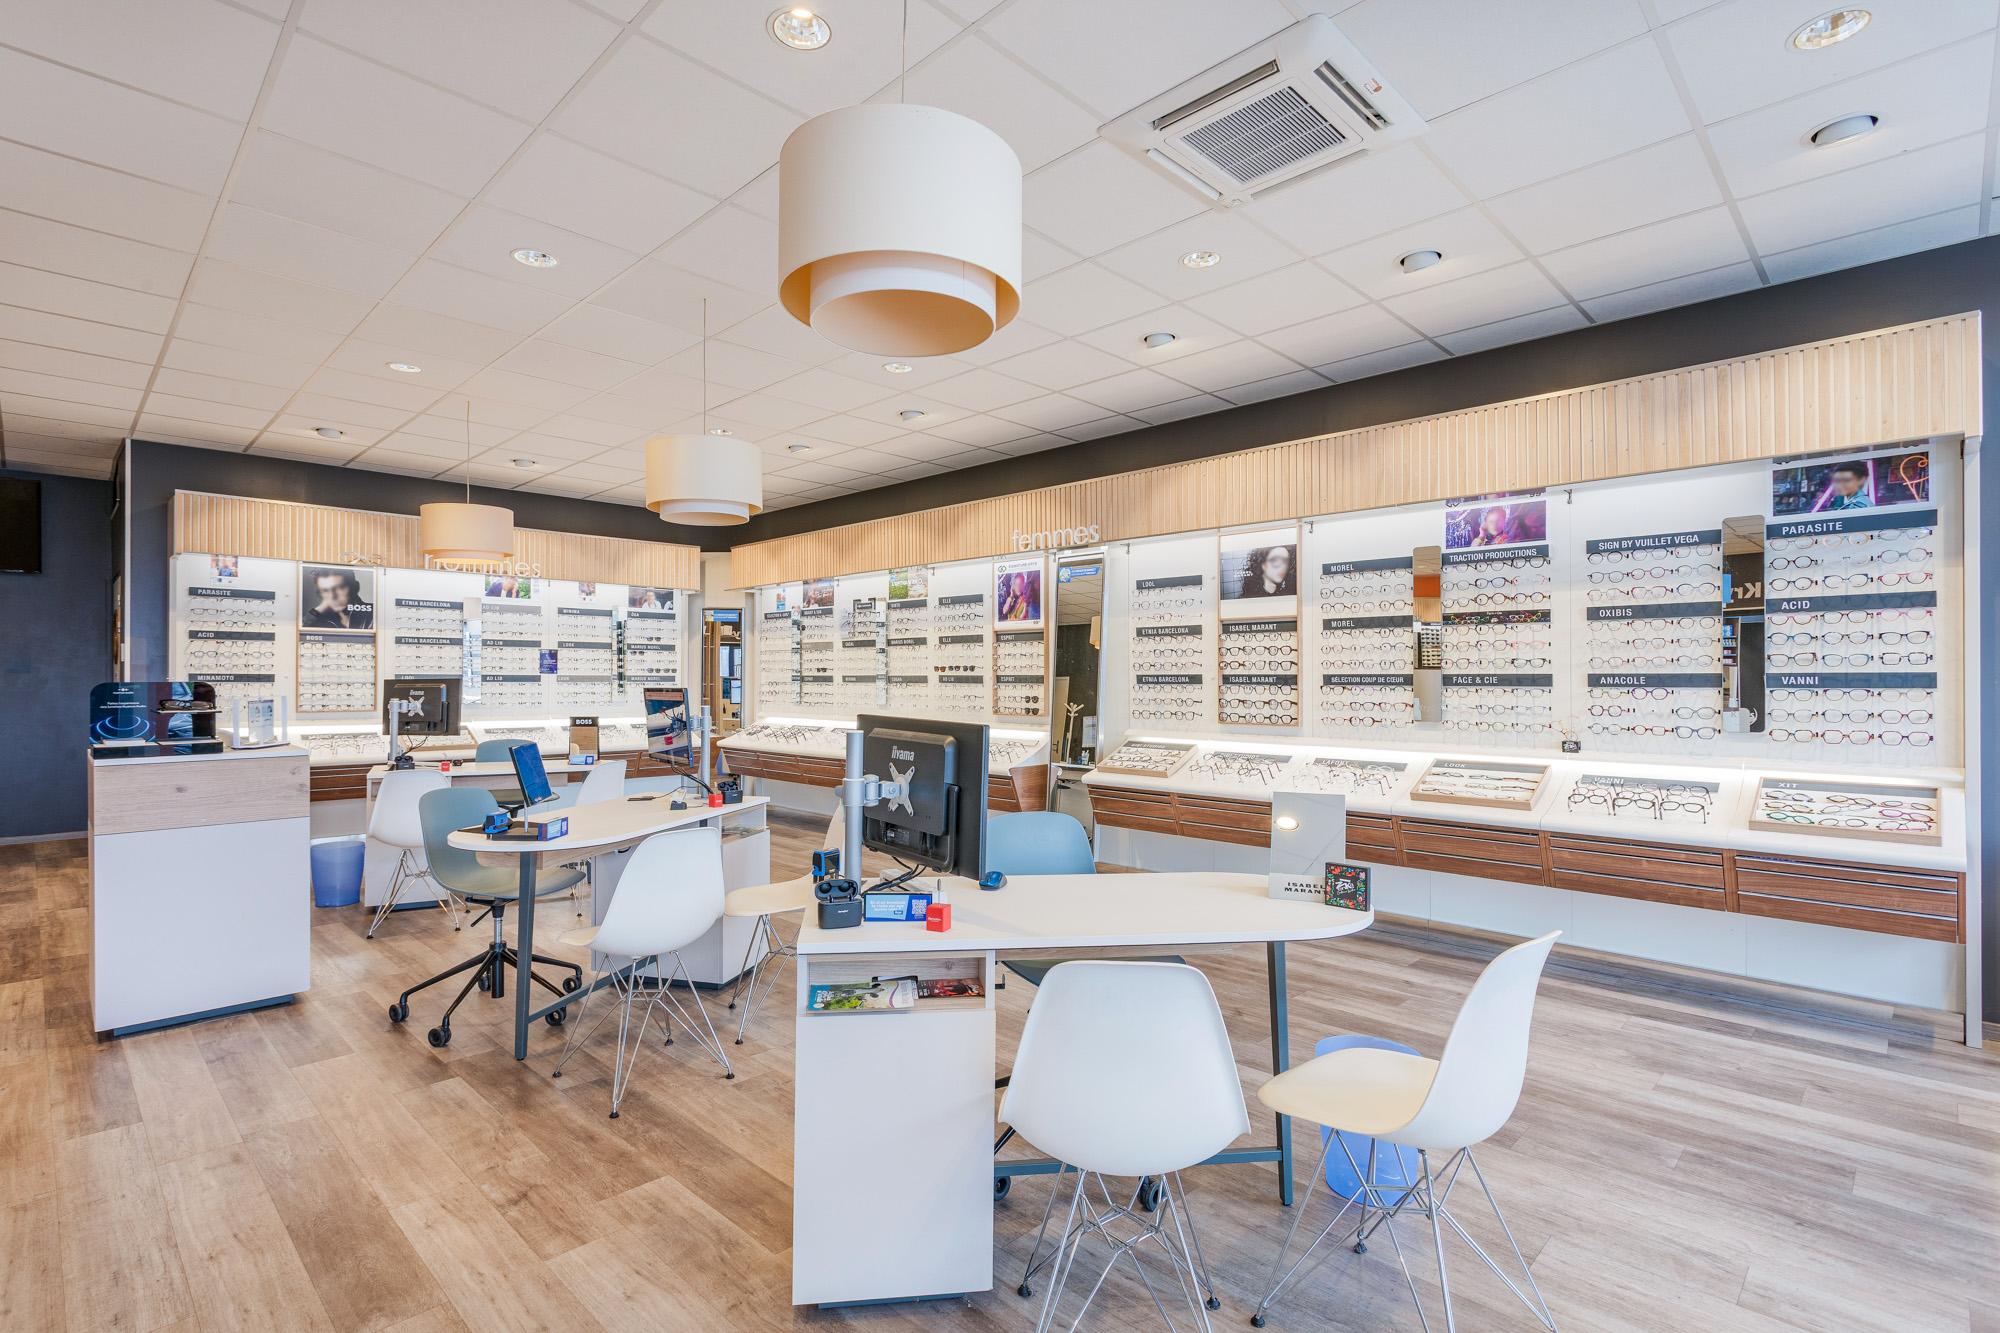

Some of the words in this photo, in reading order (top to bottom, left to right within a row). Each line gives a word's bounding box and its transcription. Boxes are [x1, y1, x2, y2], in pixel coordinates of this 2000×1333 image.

[1782, 522, 1843, 535] PARASITE
[1012, 524, 1100, 552] femmes
[1598, 541, 1620, 550] SIGN
[1621, 540, 1634, 548] BY
[1635, 537, 1672, 547] VUILLET
[1674, 534, 1699, 544] VEGA
[1449, 553, 1484, 563] TRACTION
[1485, 549, 1537, 560] PRODUCTIONS
[1331, 564, 1354, 572] MOREL
[1781, 600, 1810, 610] ACID
[1599, 608, 1633, 617] OXIBIS
[1331, 675, 1360, 683] SÉLECTION
[1452, 676, 1473, 684] FACE
[1484, 676, 1498, 684] CIE
[1599, 676, 1646, 685] ANACOLE
[1781, 676, 1819, 685] VANNI
[892, 746, 915, 762] iiyama
[1594, 776, 1624, 785] VANNI
[1287, 882, 1325, 890] ISABEL
